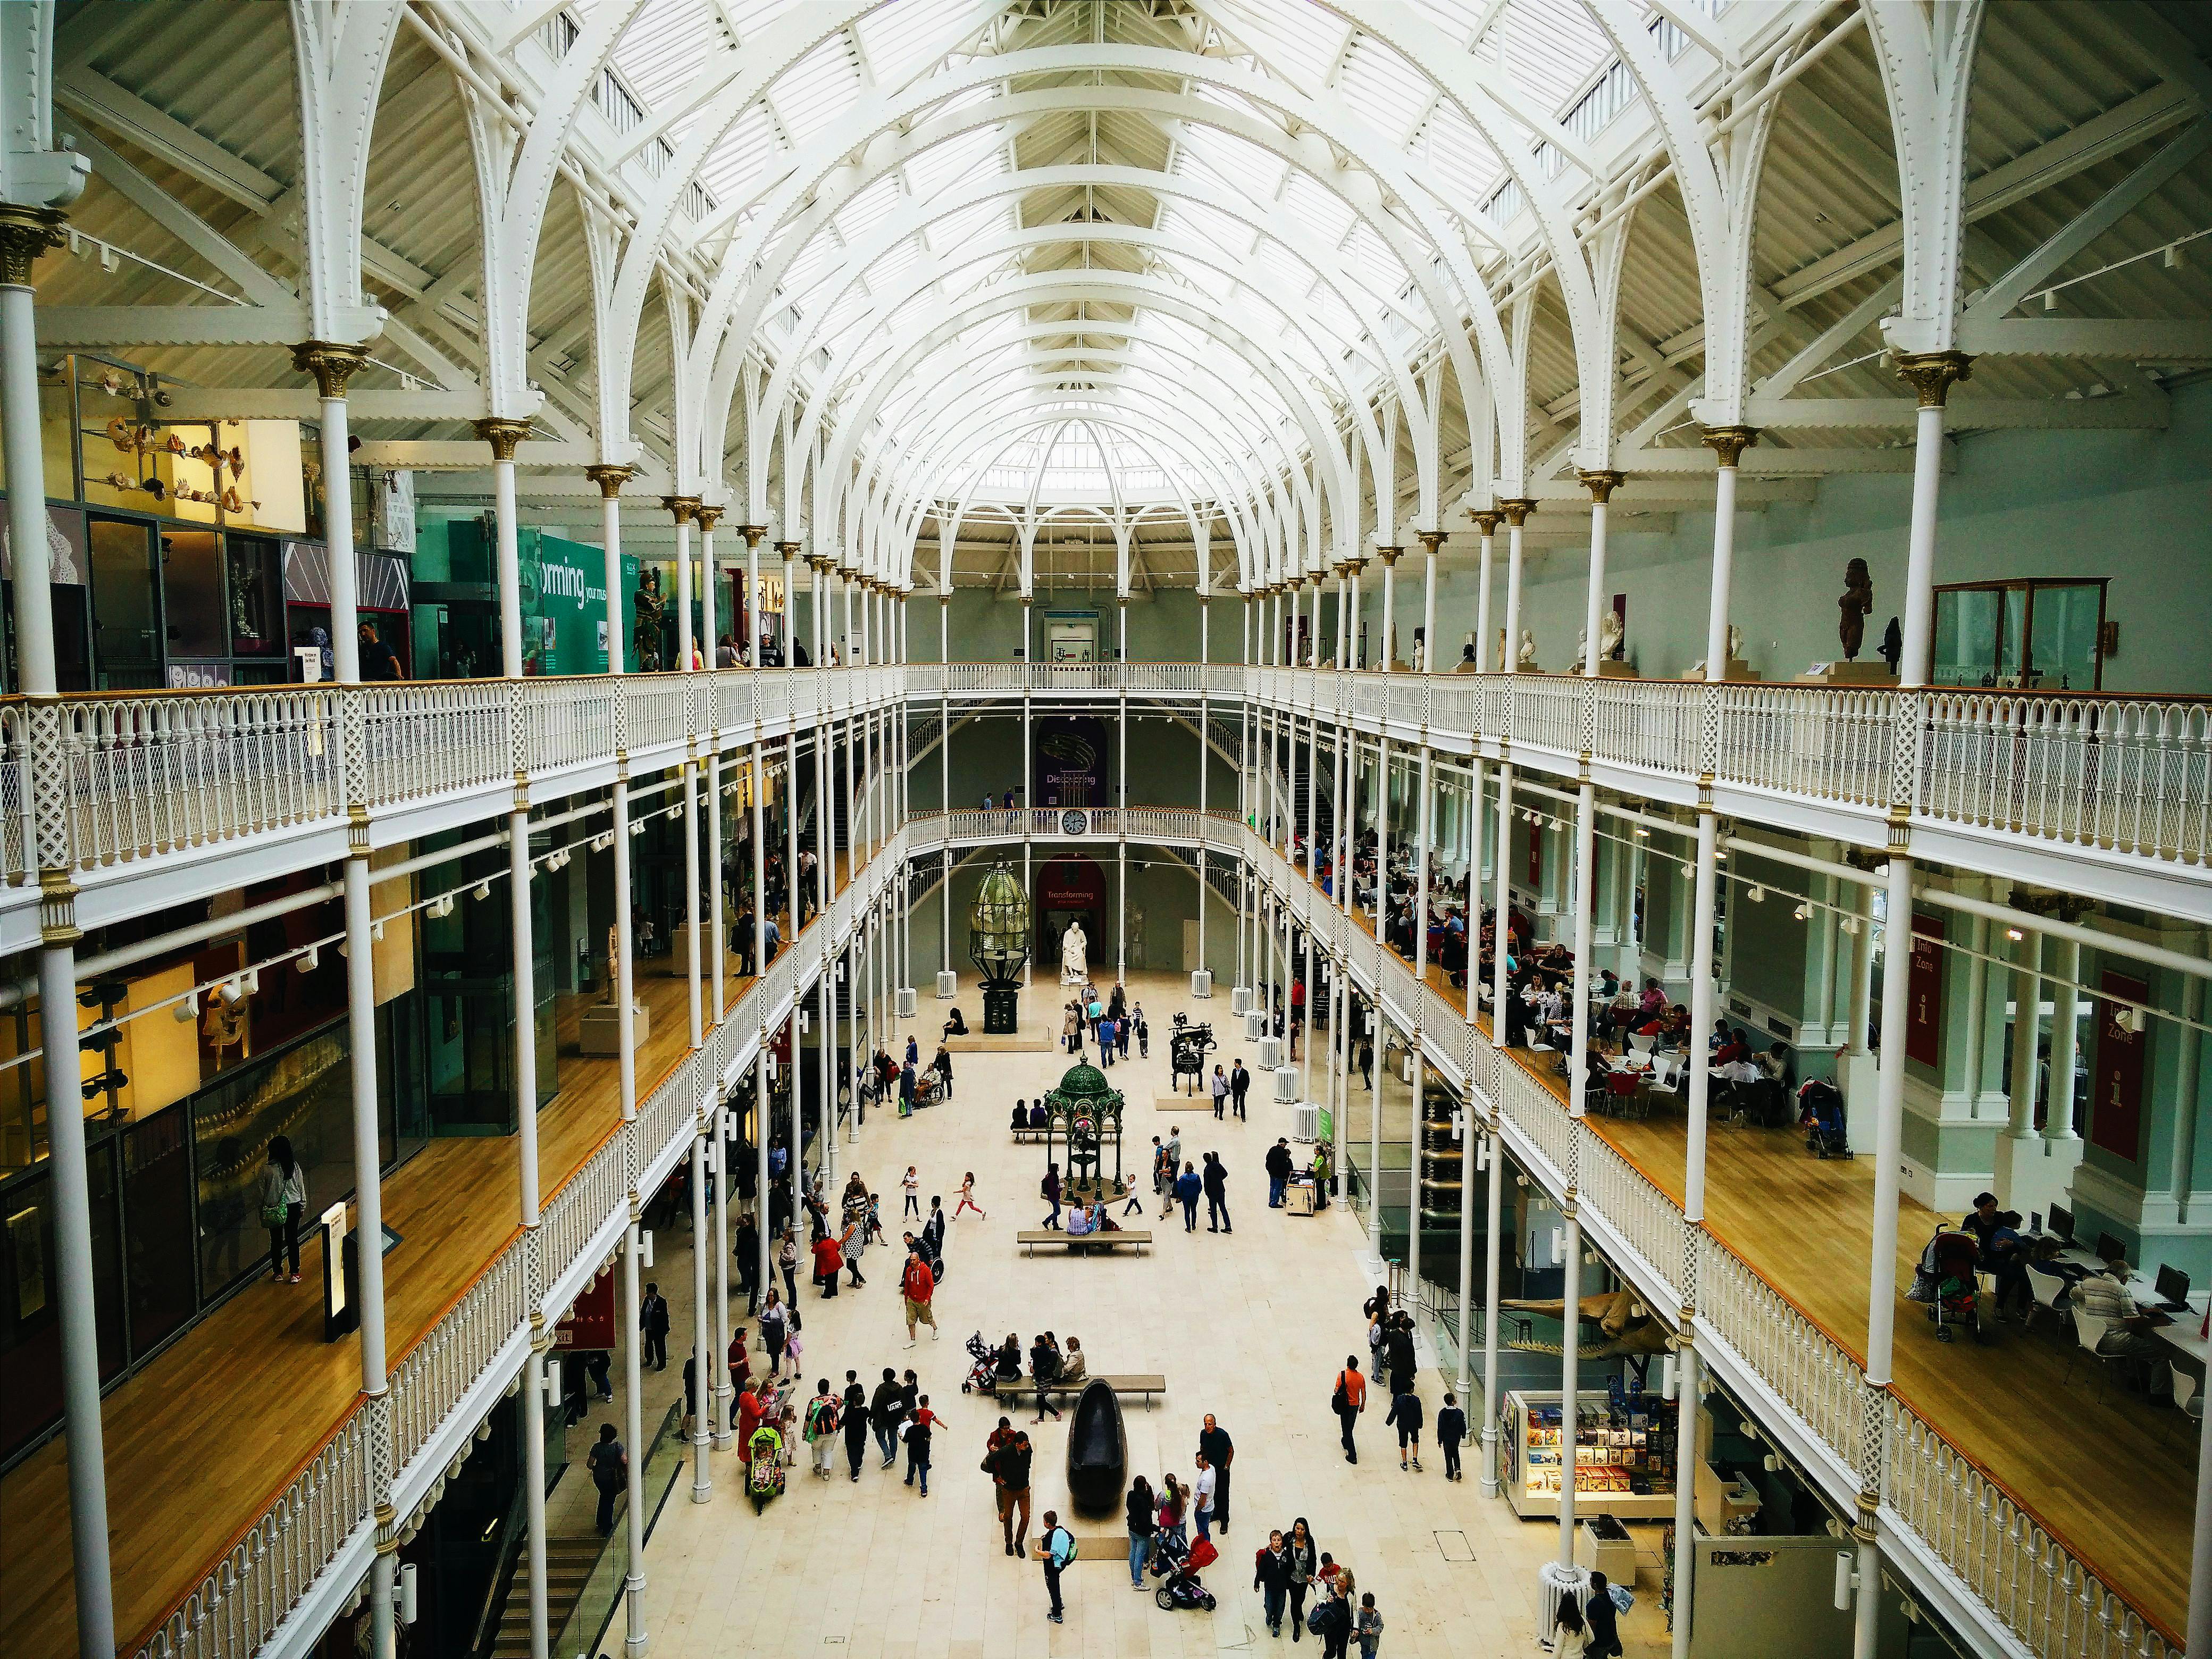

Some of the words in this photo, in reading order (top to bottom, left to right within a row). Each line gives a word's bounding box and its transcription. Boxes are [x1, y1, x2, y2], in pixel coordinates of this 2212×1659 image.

[585, 586, 596, 603] your
[1047, 891, 1093, 900] Transforming
[1917, 939, 1932, 954] Info
[1916, 956, 1933, 972] Zone
[2108, 1023, 2133, 1044] Zone
[557, 1333, 570, 1342] xit
[887, 1400, 903, 1412] VANS
